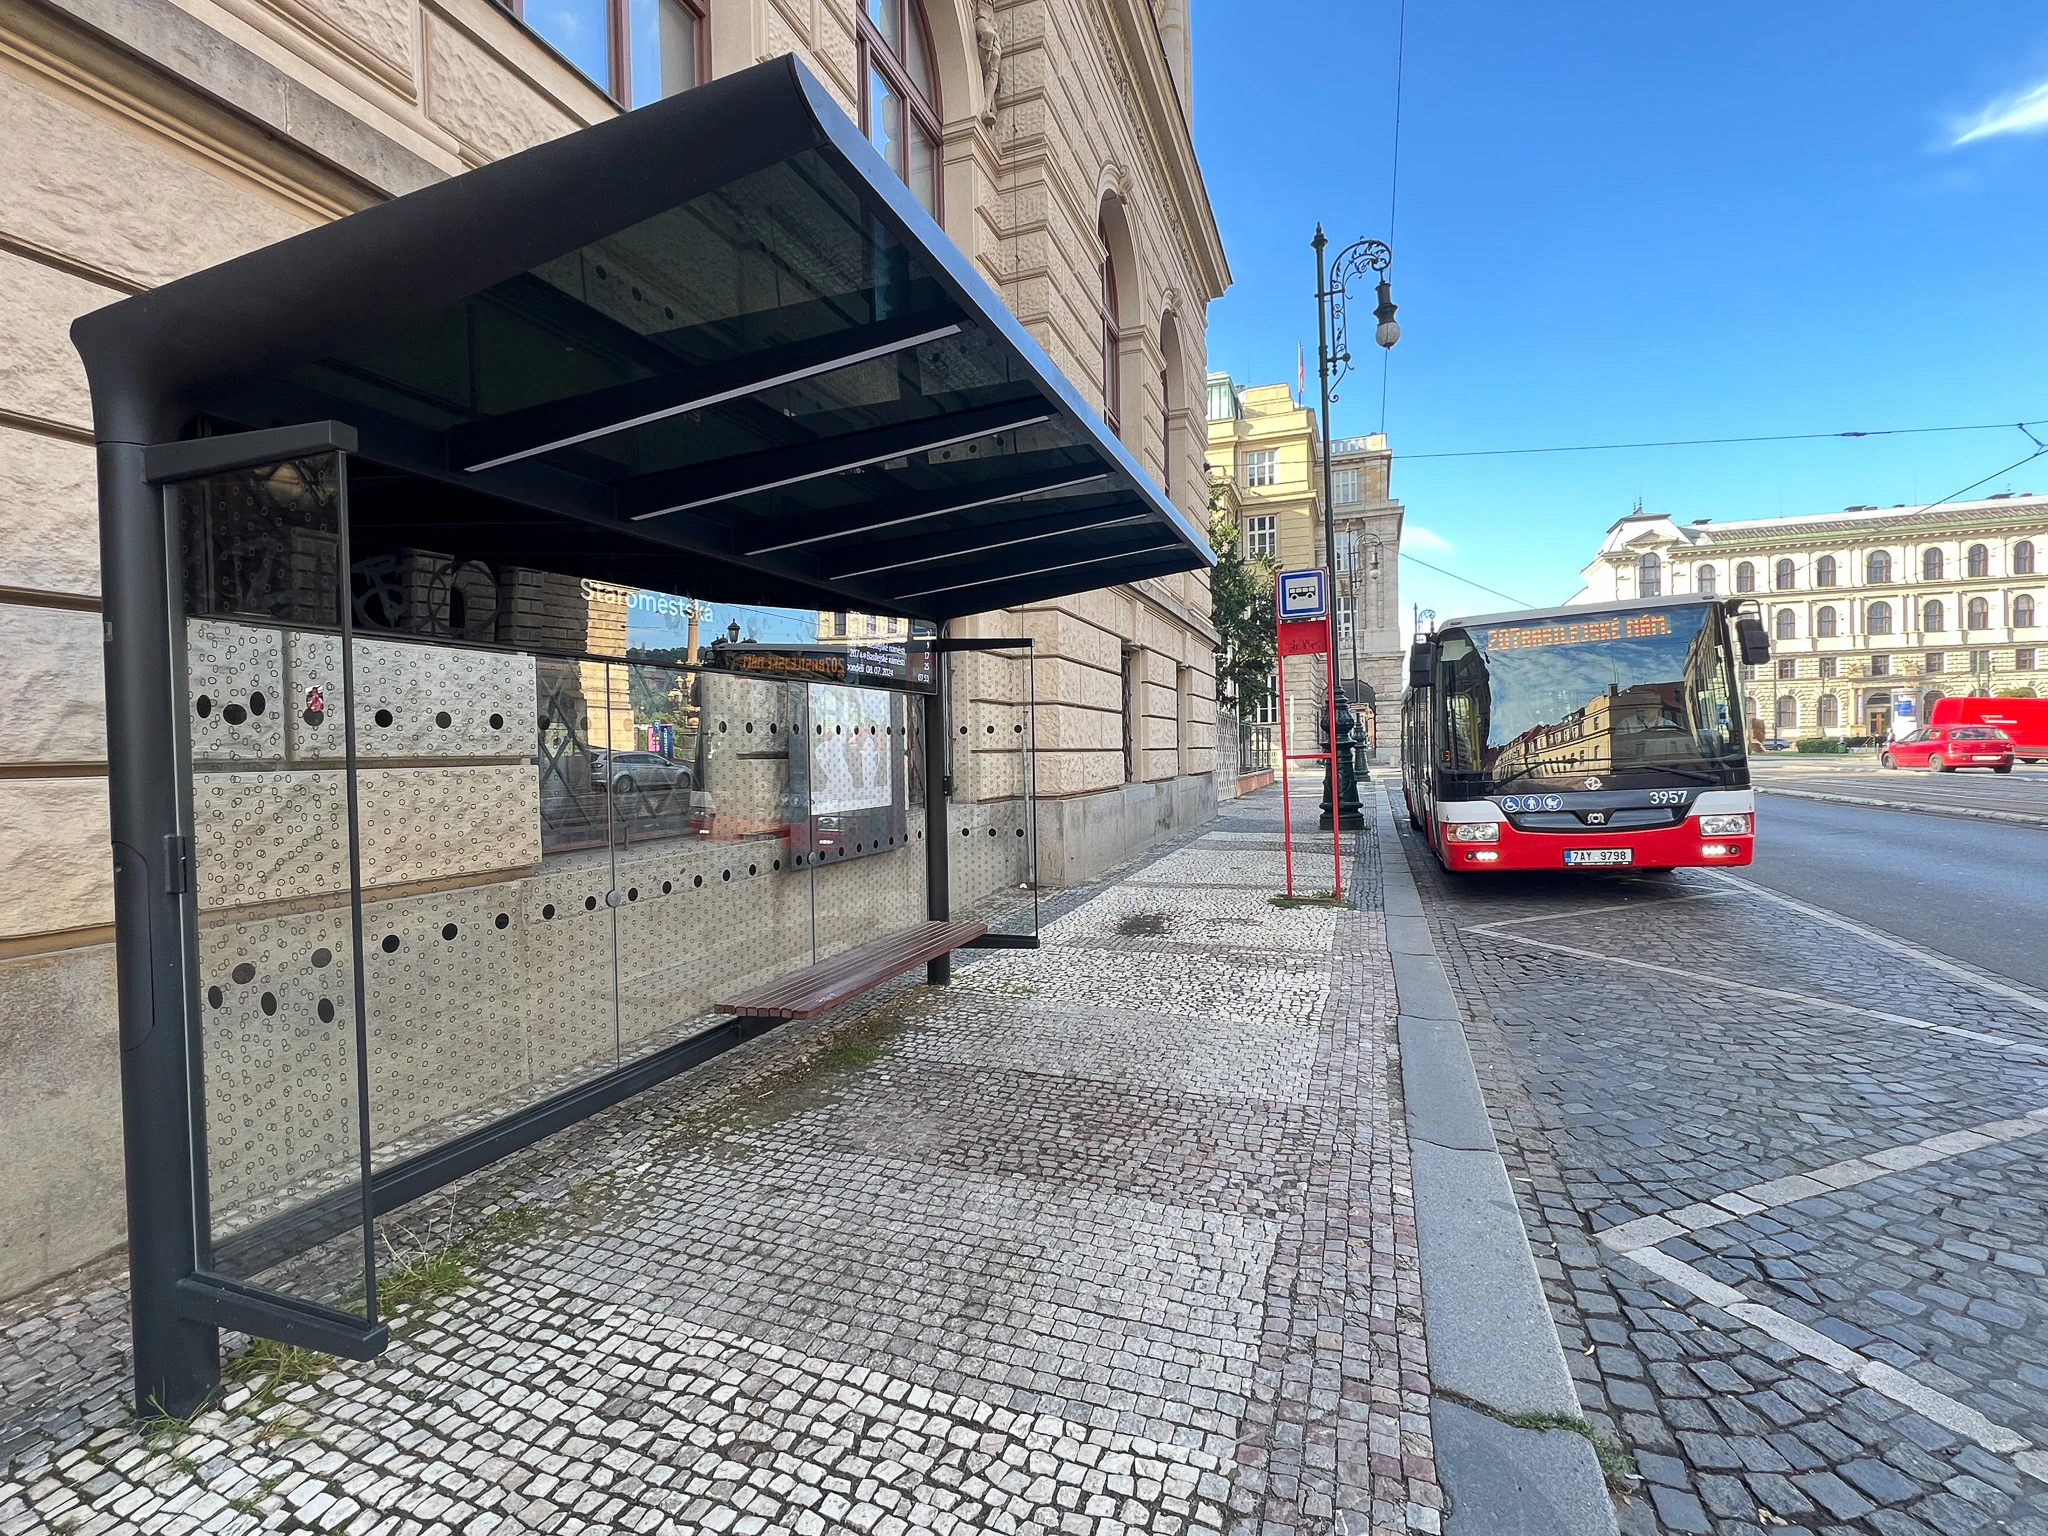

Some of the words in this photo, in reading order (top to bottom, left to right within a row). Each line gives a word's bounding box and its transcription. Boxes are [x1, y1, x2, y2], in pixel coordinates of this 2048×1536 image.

[580, 578, 714, 623] Staroměstská
[1488, 628, 1520, 650] 207
[1521, 617, 1620, 648] BASILEJSKÉ
[1626, 614, 1672, 639] NÁM.
[1649, 790, 1688, 805] 3957
[1573, 851, 1592, 862] 7AY
[1600, 850, 1627, 861] 9798
